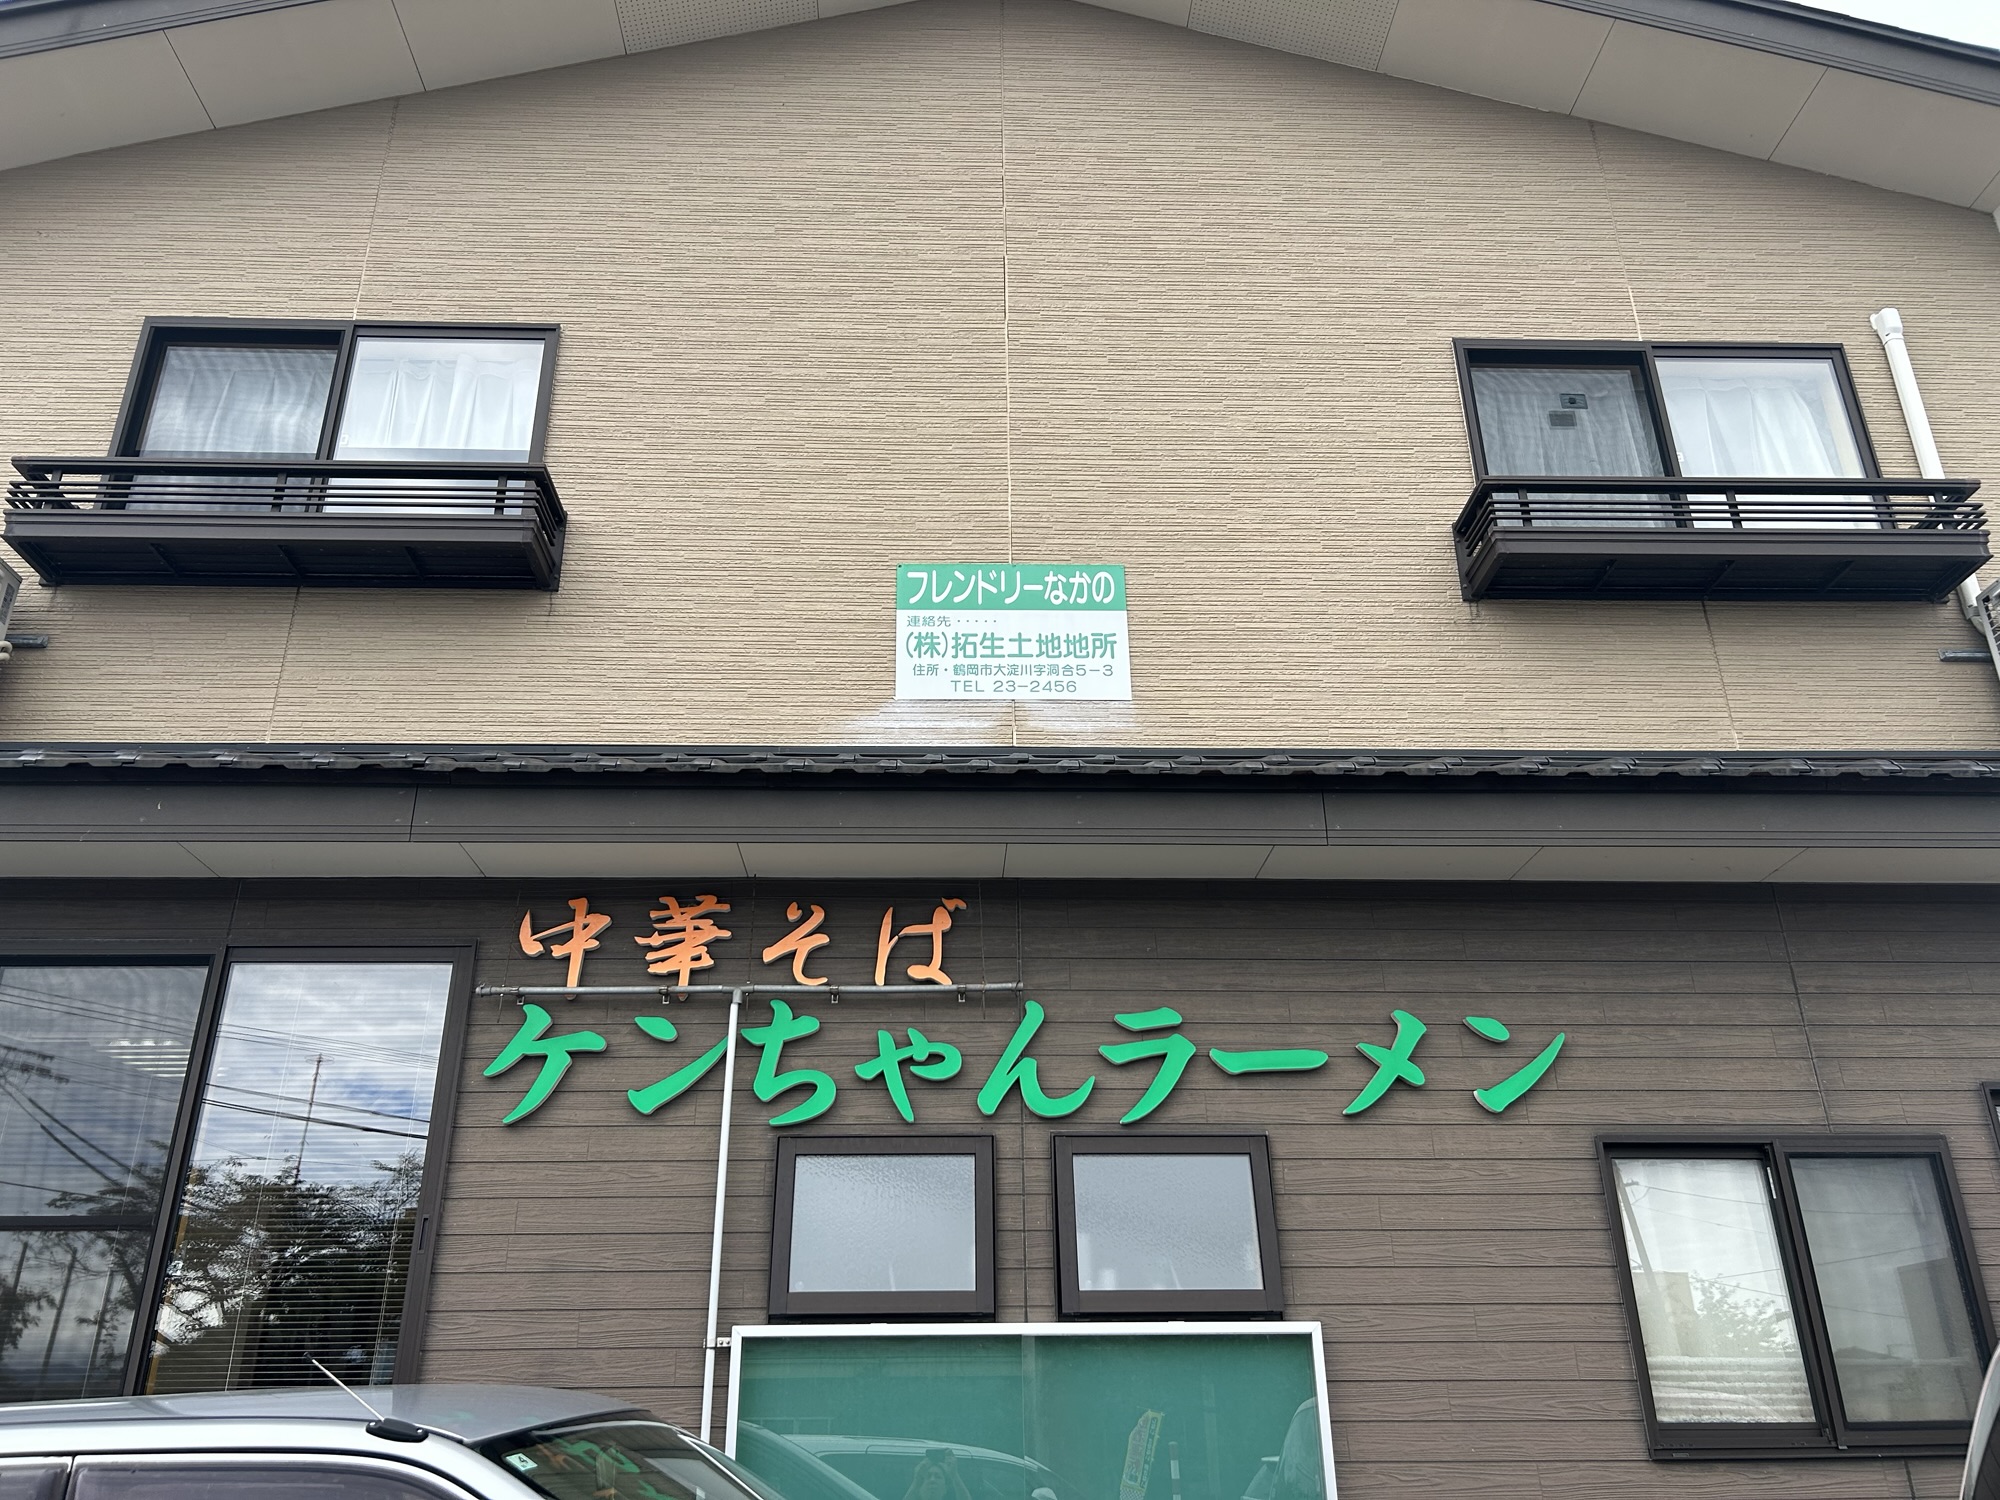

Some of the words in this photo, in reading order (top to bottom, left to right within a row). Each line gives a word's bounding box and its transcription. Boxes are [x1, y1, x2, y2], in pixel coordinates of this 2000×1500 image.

[906, 569, 1116, 605] フレンドリーなかの
[950, 680, 985, 693] TEL
[993, 680, 1078, 693] 23-2456
[518, 895, 967, 1000] 中華そば
[483, 999, 1566, 1127] ケンちゃんラーメン
